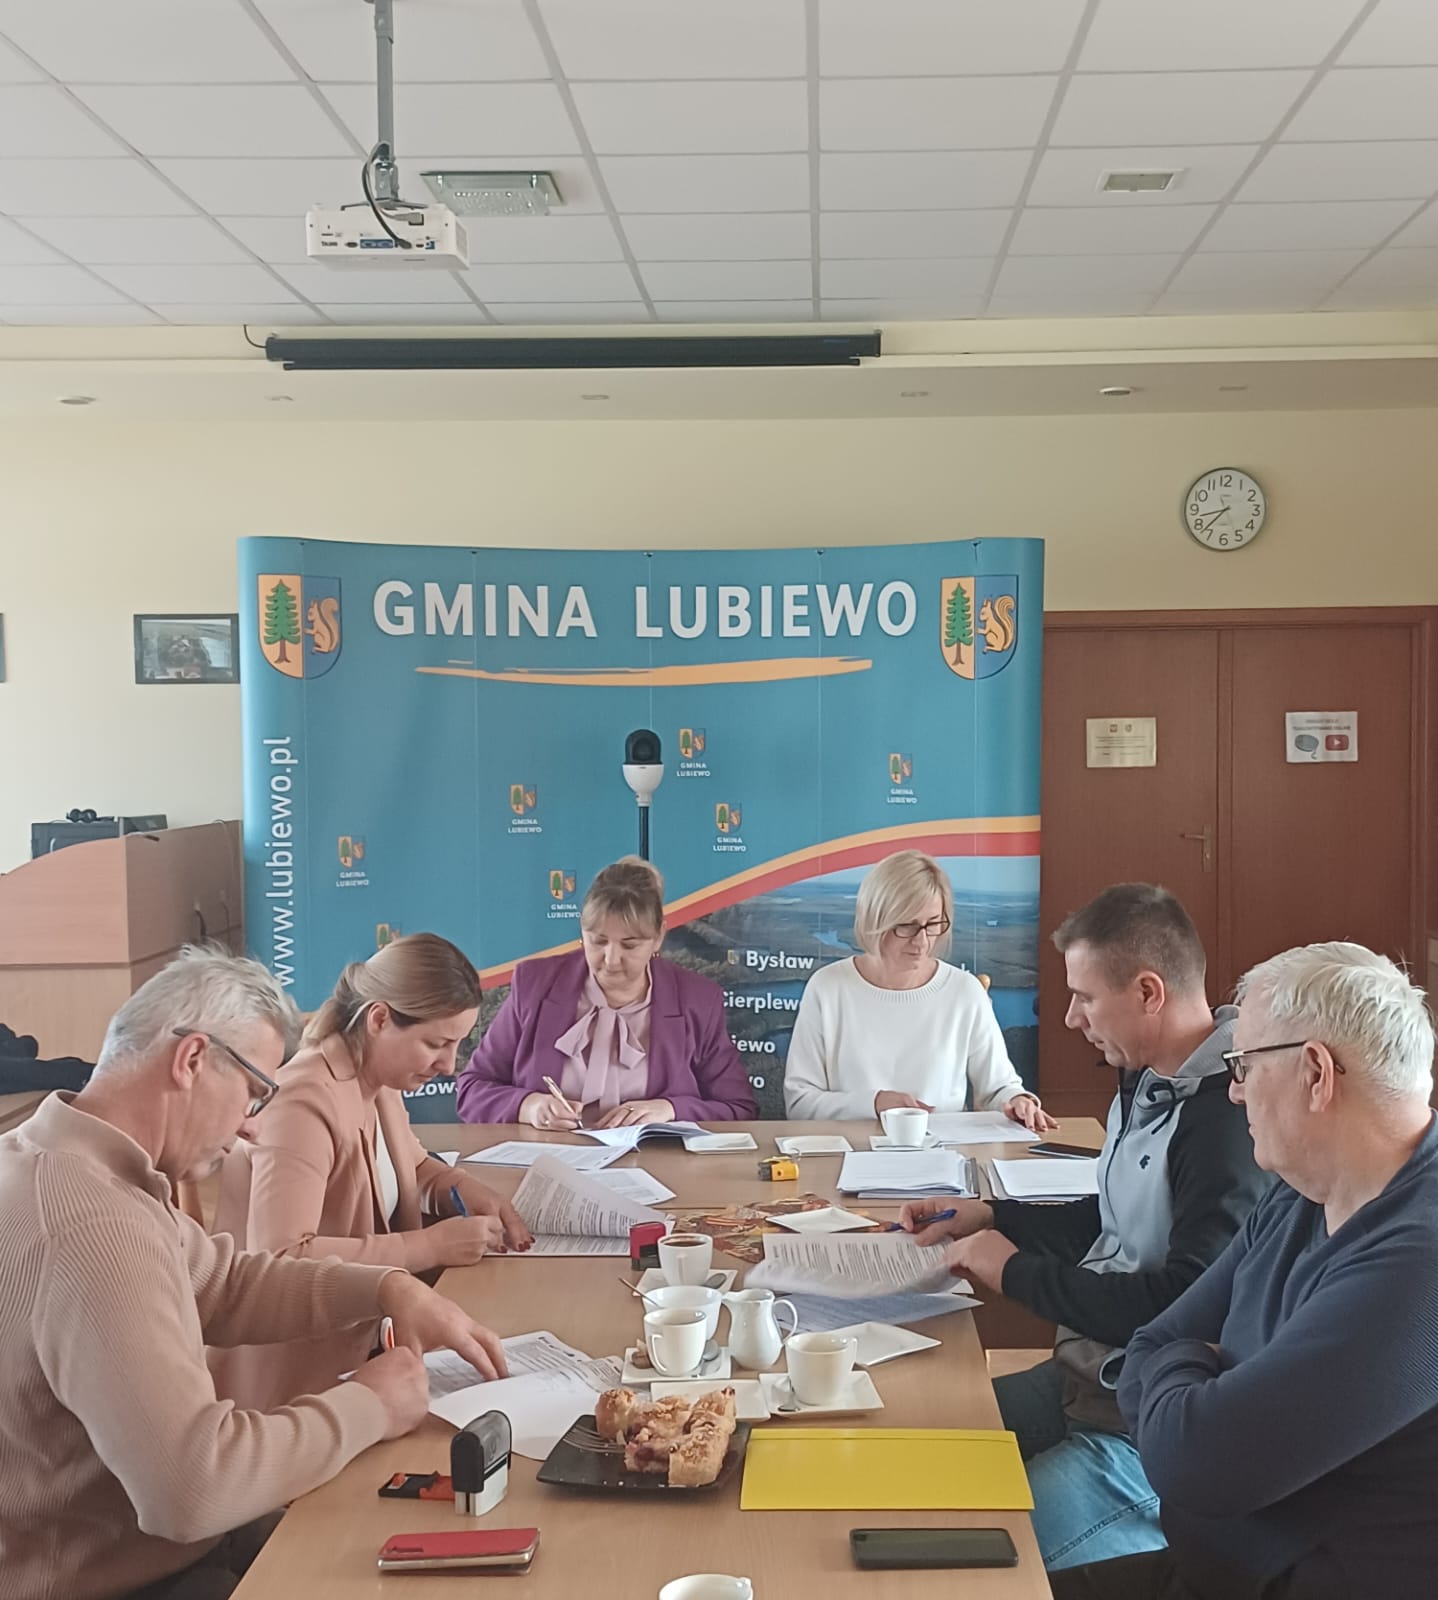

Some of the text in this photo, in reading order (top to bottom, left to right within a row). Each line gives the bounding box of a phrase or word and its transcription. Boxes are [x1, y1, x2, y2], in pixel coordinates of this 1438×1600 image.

[1207, 479, 1216, 491] 11
[1219, 474, 1233, 488] 12
[1239, 479, 1244, 491] 1
[1194, 489, 1209, 503] 10
[1247, 489, 1257, 502] 2
[1190, 503, 1200, 516] 9
[1251, 504, 1261, 517] 3
[1193, 518, 1204, 531] 8
[1245, 519, 1255, 531] 4
[1205, 528, 1214, 541] 7
[1218, 533, 1229, 546] 6
[1234, 529, 1244, 542] 5
[373, 580, 918, 639] GMINA LUBIEWO
[263, 736, 299, 988] www.lubiewo.pl
[746, 950, 814, 971] Bysław
[723, 991, 801, 1013] ierplew
